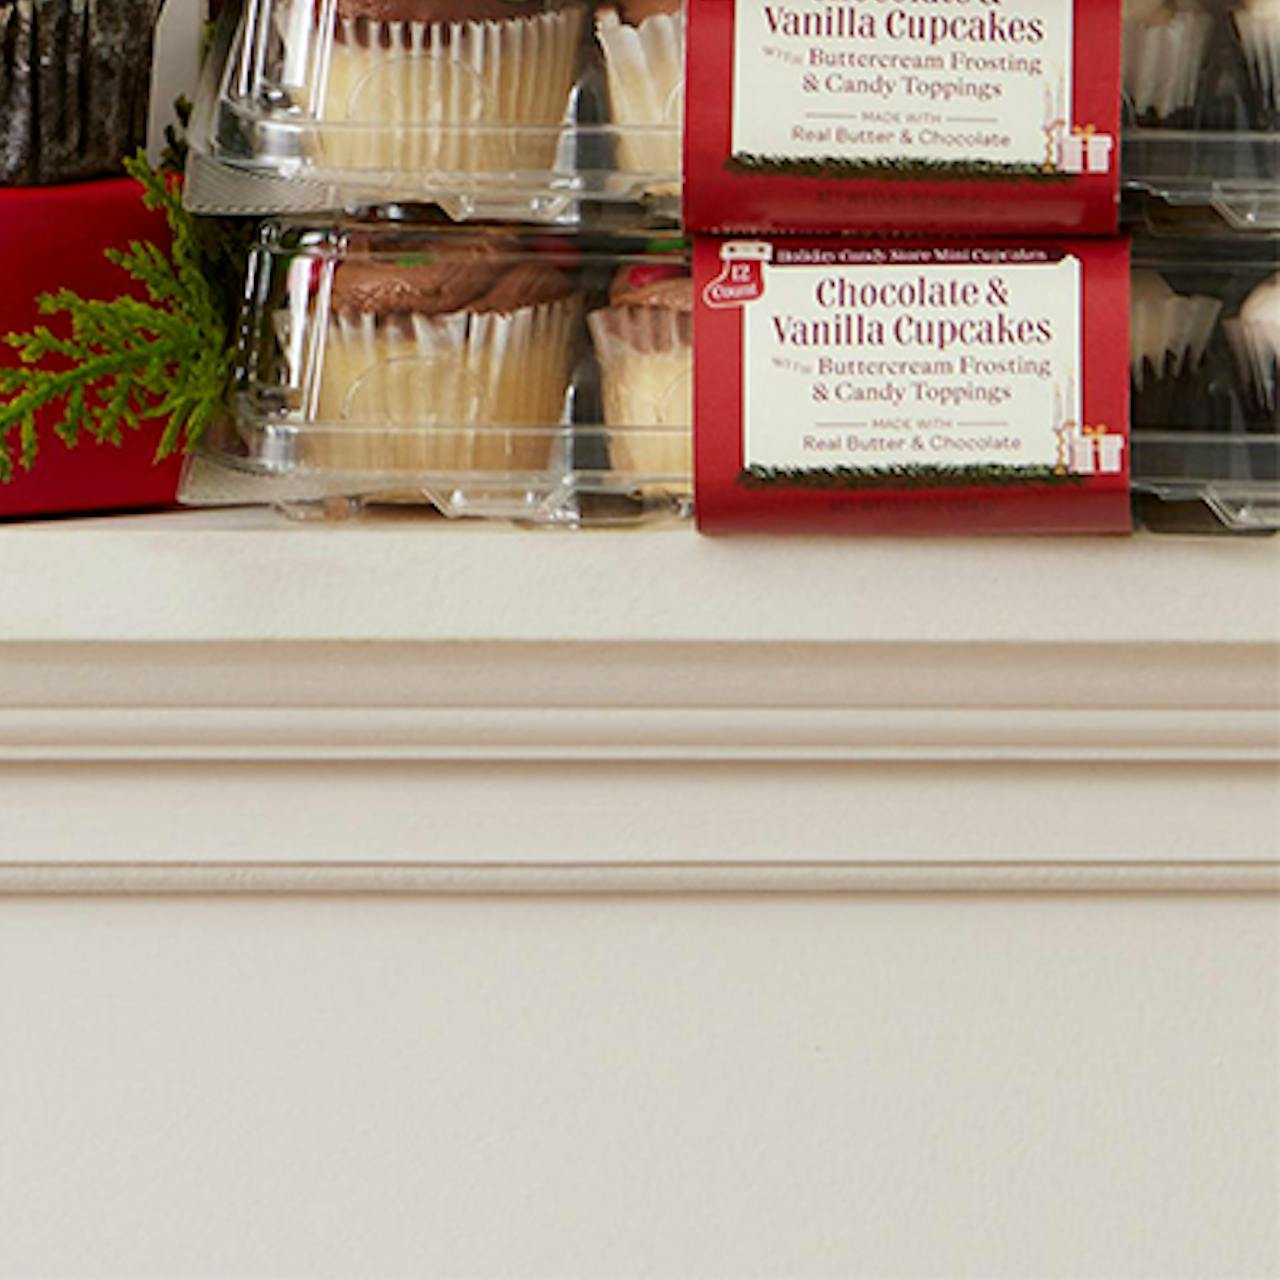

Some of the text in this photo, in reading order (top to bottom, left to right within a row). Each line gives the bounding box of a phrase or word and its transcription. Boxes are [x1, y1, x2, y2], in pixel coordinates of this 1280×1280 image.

[763, 5, 1044, 46] Vanilla Cupcakes
[808, 47, 945, 70] Buttercream
[950, 51, 1043, 76] Frosting
[801, 73, 1003, 101] & Candy Toppings
[791, 125, 1011, 148] Real Butter & Chocolate
[731, 264, 751, 282] 12
[815, 277, 1009, 308] Chocolate &
[771, 313, 1052, 350] Vanilla Cupcakes
[817, 356, 954, 377] Buttercream
[959, 355, 1051, 378] Frosting
[811, 382, 1012, 406] & Candy Toppings
[802, 435, 1021, 452] Real Butter & Chocolate
